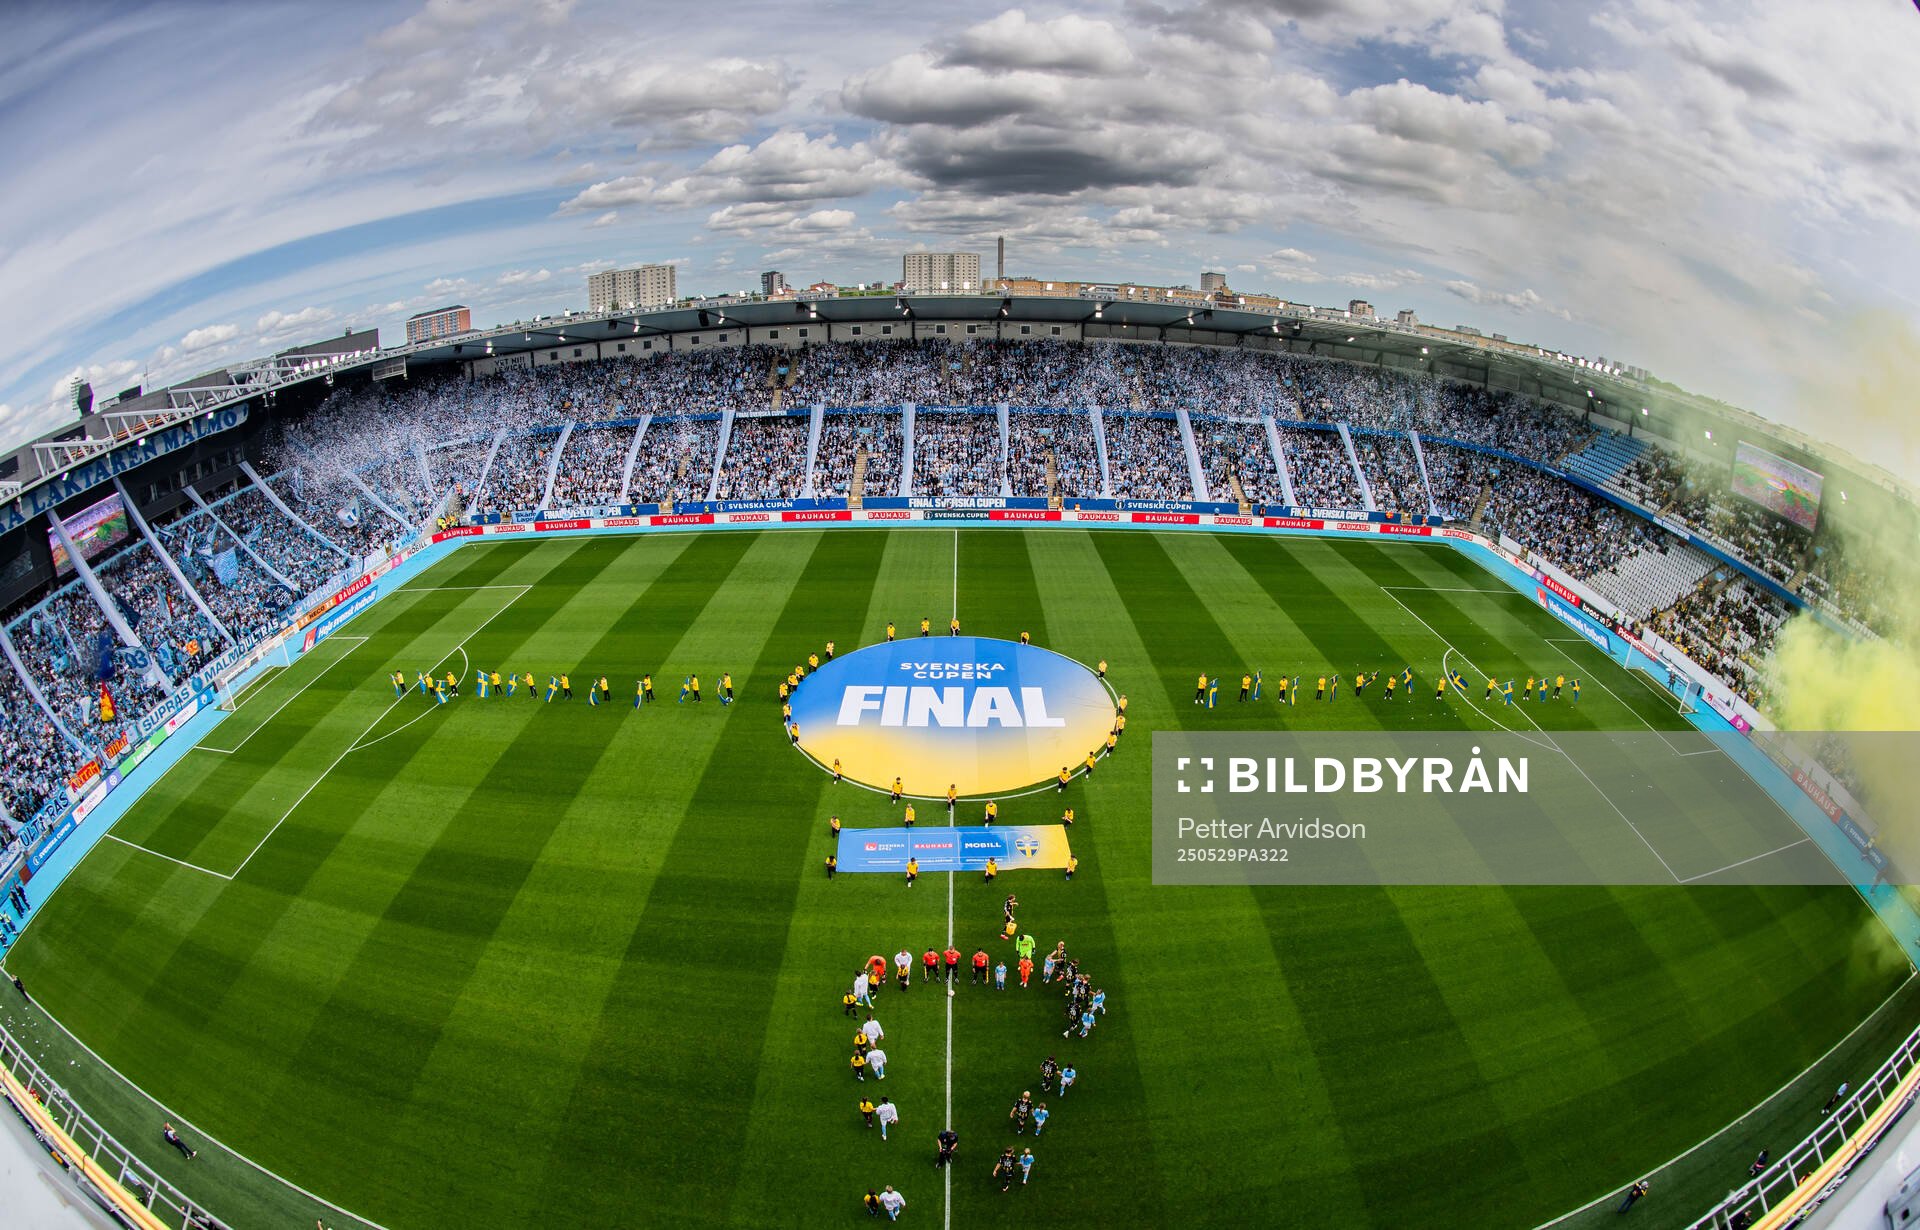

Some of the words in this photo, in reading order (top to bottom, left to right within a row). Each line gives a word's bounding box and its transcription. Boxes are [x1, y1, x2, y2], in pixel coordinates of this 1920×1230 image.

[728, 502, 764, 510] SVENSKA
[908, 498, 934, 508] FINAL
[935, 498, 976, 508] SVENSKA
[976, 498, 1007, 508] CUPEN
[1128, 502, 1164, 510] SVENSKA
[1165, 503, 1192, 511] CUPEN
[729, 514, 769, 522] BAUHAUS
[867, 511, 911, 519] BAUHAUS
[1077, 513, 1119, 521] BAUHAUS
[1145, 515, 1185, 523] BAUHAUS
[1312, 508, 1345, 520] SVENSKA
[1346, 511, 1369, 521] CUPEN
[603, 519, 640, 527] BAUHAUS
[662, 516, 700, 524] BAUHAUS
[1213, 517, 1253, 526] BAUHAUS
[1275, 520, 1311, 528] BAUHAUS
[494, 525, 526, 534] BAUHAUS
[1336, 523, 1370, 532] BAUHAUS
[442, 529, 474, 540] BAUHAUS
[1442, 530, 1474, 541] BAUHAUS
[338, 577, 368, 602] BAUHAUS
[1546, 578, 1577, 603] BAUHAUS
[900, 662, 1006, 671] SVENSKA
[913, 671, 992, 680] CUPEN
[142, 686, 191, 732] SUPRAS
[836, 686, 1066, 728] FINAL
[1796, 772, 1837, 816] BAUHAUS
